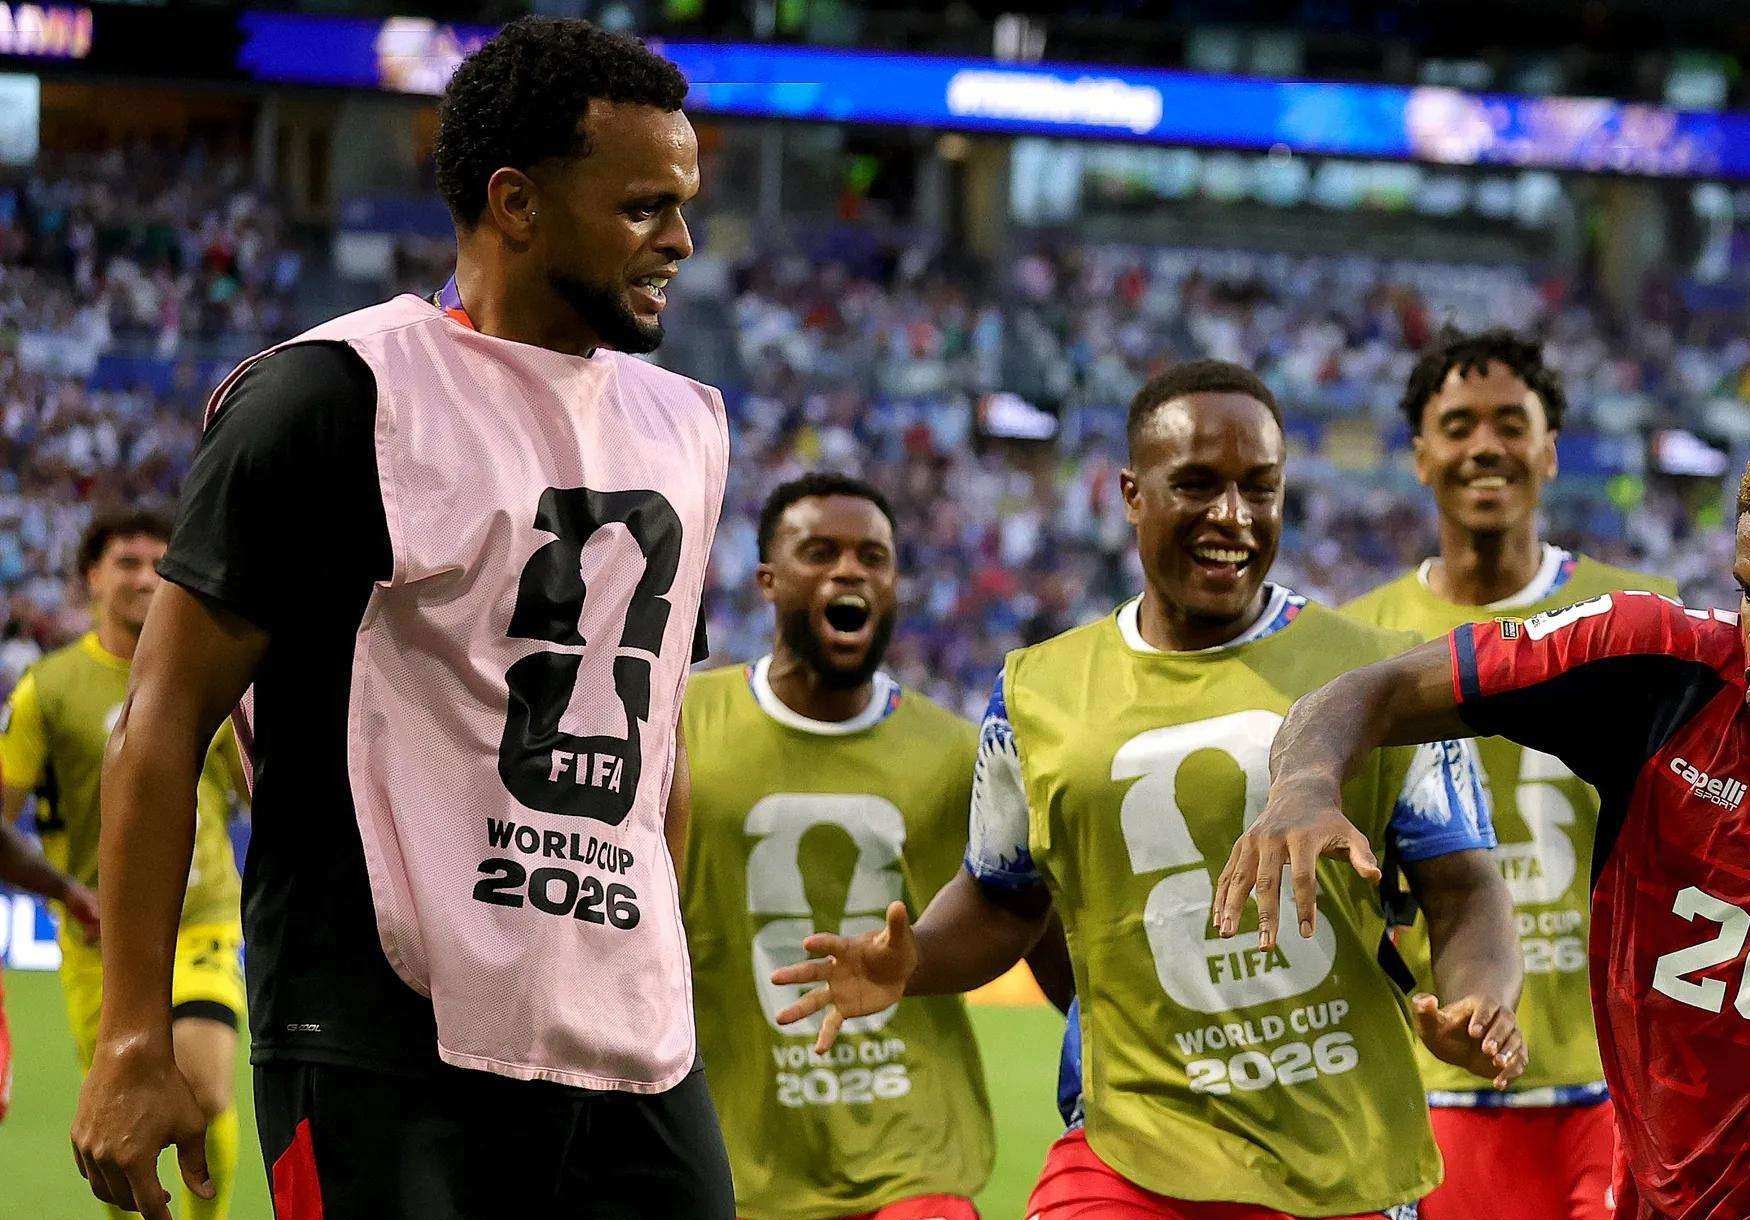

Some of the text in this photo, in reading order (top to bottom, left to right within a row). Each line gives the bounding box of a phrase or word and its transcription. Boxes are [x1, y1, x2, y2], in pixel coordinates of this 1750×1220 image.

[549, 751, 624, 794] FIFA
[1670, 757, 1748, 806] capelli
[1694, 788, 1738, 811] SPORT
[487, 817, 635, 876] WORLD CUP
[472, 857, 641, 931] 2026
[1206, 948, 1292, 986] FIFA
[1522, 936, 1586, 973] 26
[1174, 998, 1350, 1056] WORLD CUP
[775, 1063, 912, 1109] 2026
[1184, 1031, 1360, 1097] 2026
